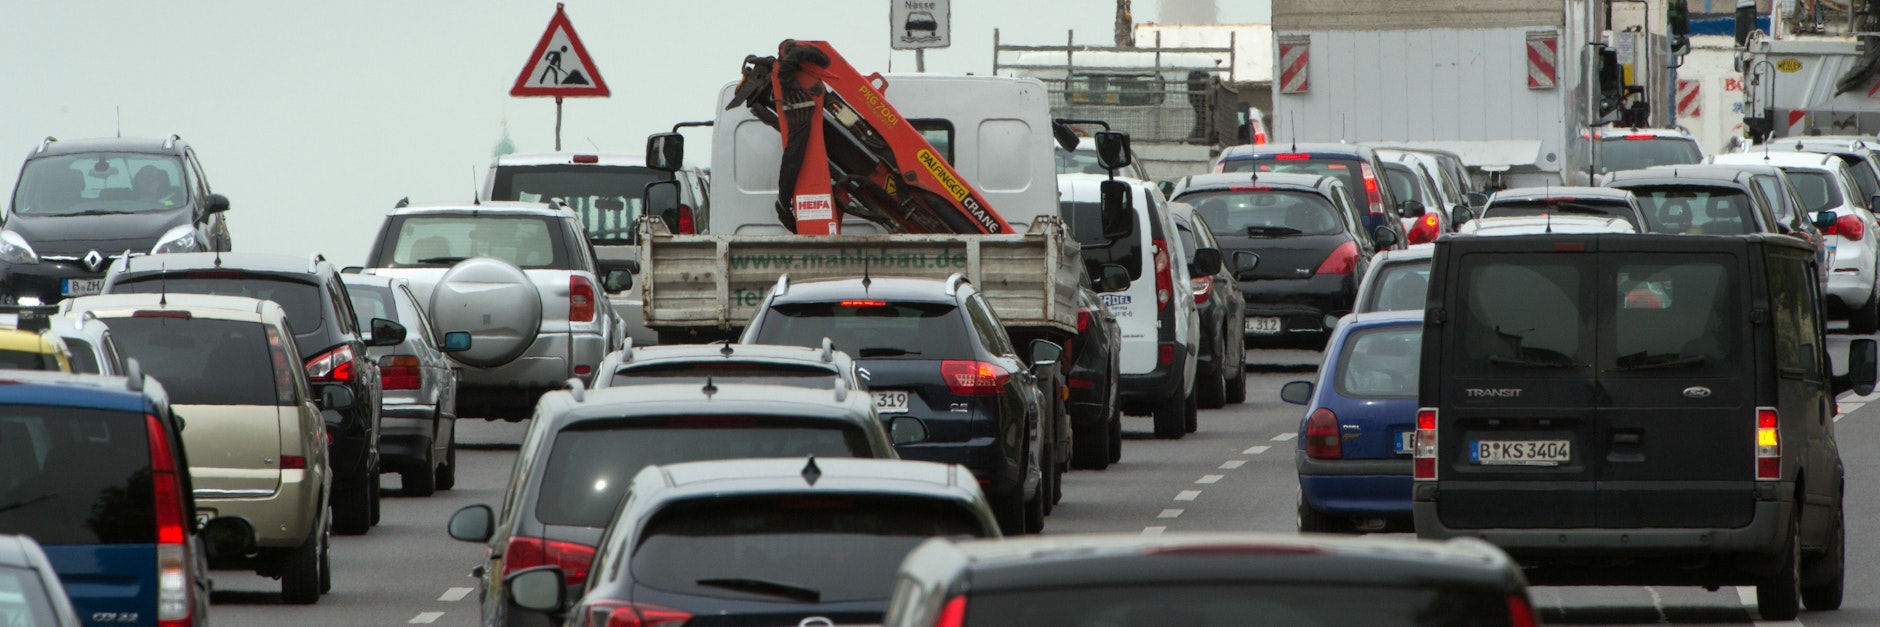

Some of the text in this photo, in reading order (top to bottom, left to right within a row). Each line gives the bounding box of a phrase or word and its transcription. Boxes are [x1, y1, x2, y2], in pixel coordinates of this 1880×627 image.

[920, 151, 999, 233] PALFINGER CRANE
[799, 200, 829, 210] HEIFA
[1256, 320, 1277, 330] 312
[1466, 388, 1522, 397] TRANSIT
[877, 393, 906, 407] 319
[1480, 443, 1567, 459] B KS 3404
